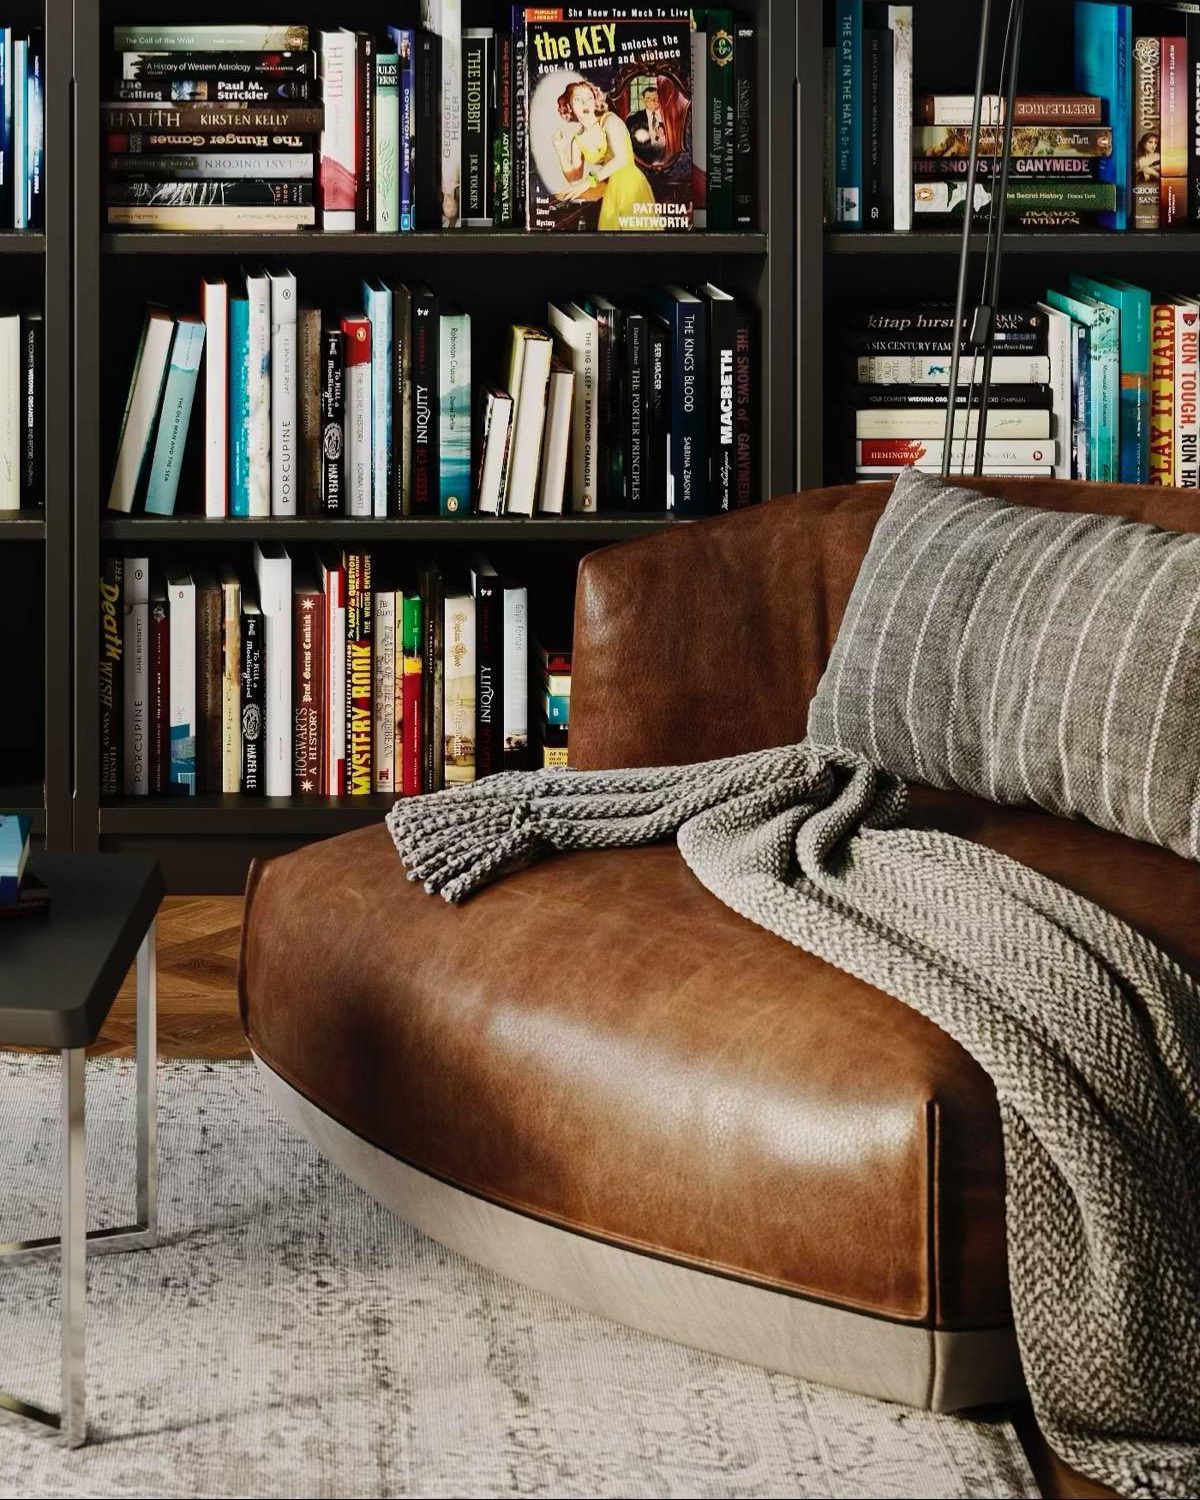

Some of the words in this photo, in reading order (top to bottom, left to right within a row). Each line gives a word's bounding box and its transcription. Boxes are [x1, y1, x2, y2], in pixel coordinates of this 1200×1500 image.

[569, 9, 583, 18] She
[587, 9, 609, 18] Knew
[612, 9, 627, 18] Too
[631, 9, 652, 18] Much
[657, 9, 665, 18] To
[670, 9, 688, 18] Live
[842, 15, 852, 36] THE
[534, 31, 571, 62] the
[574, 23, 617, 56] KEY
[621, 36, 658, 51] unlocks
[663, 35, 678, 46] the
[842, 40, 852, 61] CAT
[154, 63, 177, 73] History
[218, 63, 251, 73] Astrology
[467, 50, 481, 78] THE
[538, 61, 558, 74] door
[563, 60, 574, 70] to
[579, 57, 612, 70] murder
[618, 54, 635, 64] and
[641, 49, 681, 63] violence
[842, 65, 852, 76] IN
[218, 81, 244, 90] Paul
[248, 81, 263, 90] M.
[218, 91, 269, 100] Strickler
[842, 80, 852, 100] THE
[467, 81, 481, 132] HOBBIT
[842, 104, 852, 125] HAT
[200, 114, 251, 125] KIRSTEN
[255, 114, 289, 125] KELLY
[1016, 160, 1089, 172] GANYMEDE
[469, 174, 478, 209] TOLKIEN
[633, 203, 687, 214] PATRICIA
[618, 216, 689, 228] WENTWORTH
[684, 314, 695, 334] THE
[868, 316, 911, 330] kitap
[584, 332, 592, 347] THE
[872, 342, 886, 351] SIX
[888, 342, 930, 351] CENTURY
[1153, 304, 1175, 381] HARD
[1182, 332, 1196, 364] RUN
[584, 349, 592, 364] BIG
[684, 338, 695, 371] KING'S
[584, 367, 592, 389] SLEEP
[684, 375, 695, 412] BLOOD
[720, 350, 733, 444] MACBETH
[1152, 390, 1172, 416] IT
[1179, 371, 1196, 428] TOUGH,
[584, 400, 592, 442] RAYMOND
[683, 437, 692, 468] SABRINA
[1152, 426, 1172, 487] PLAY
[1182, 434, 1196, 463] RUN
[282, 421, 291, 503] PORCUPINE
[584, 444, 592, 487] CHANDLER
[327, 464, 338, 493] HARPER
[683, 470, 692, 500] ZBASNIK
[327, 495, 338, 508] LEE
[135, 700, 143, 782] PORCUPINE
[295, 708, 307, 777] HOGWARTS
[309, 708, 317, 760] HISTORY
[246, 744, 256, 774] HARPER
[351, 707, 371, 794] MYSTERY
[246, 776, 256, 789] LEE
[309, 767, 317, 775] A
